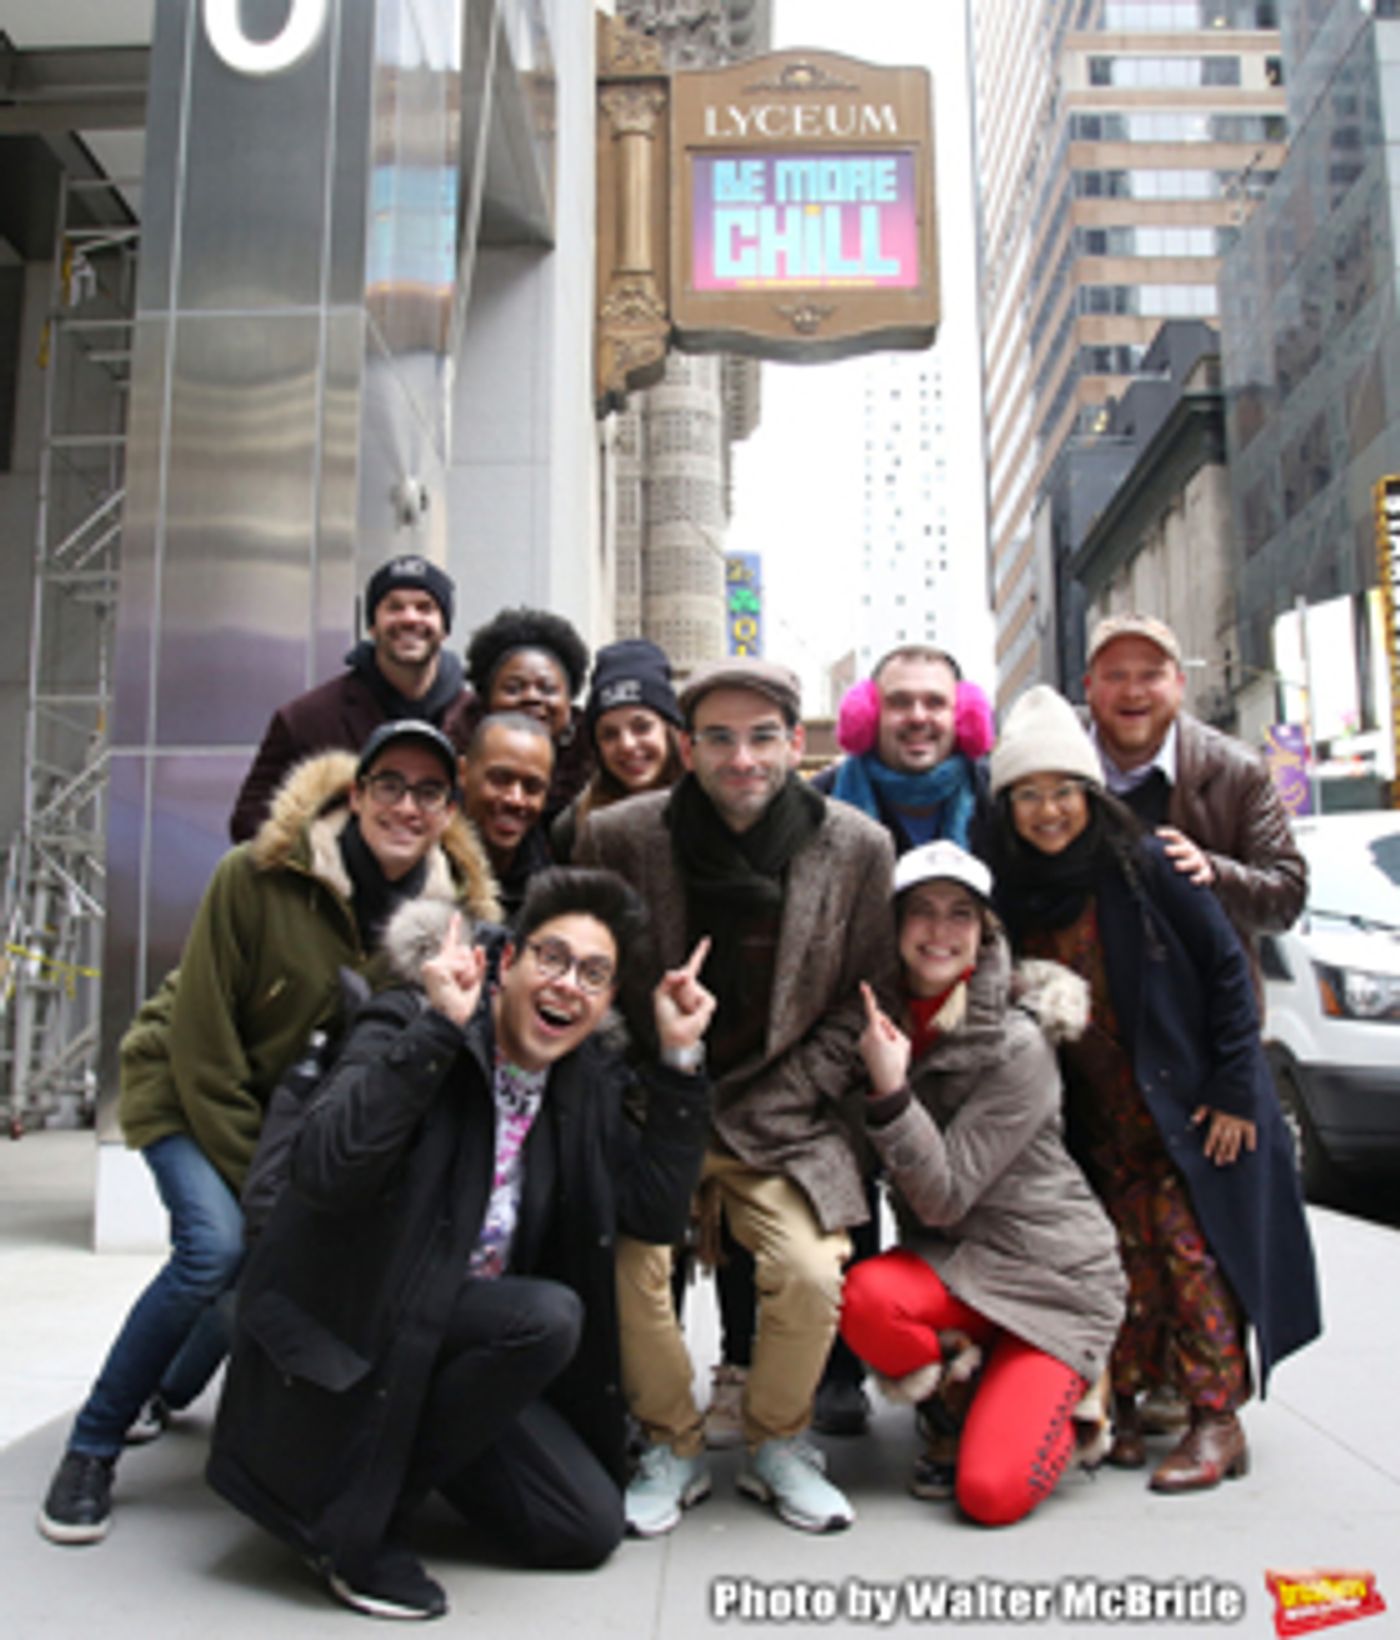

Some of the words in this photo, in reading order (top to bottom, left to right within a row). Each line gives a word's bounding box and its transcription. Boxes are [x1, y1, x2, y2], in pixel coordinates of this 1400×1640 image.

[704, 104, 898, 137] LYCEUM
[712, 160, 766, 202] BE
[774, 159, 898, 202] MORE
